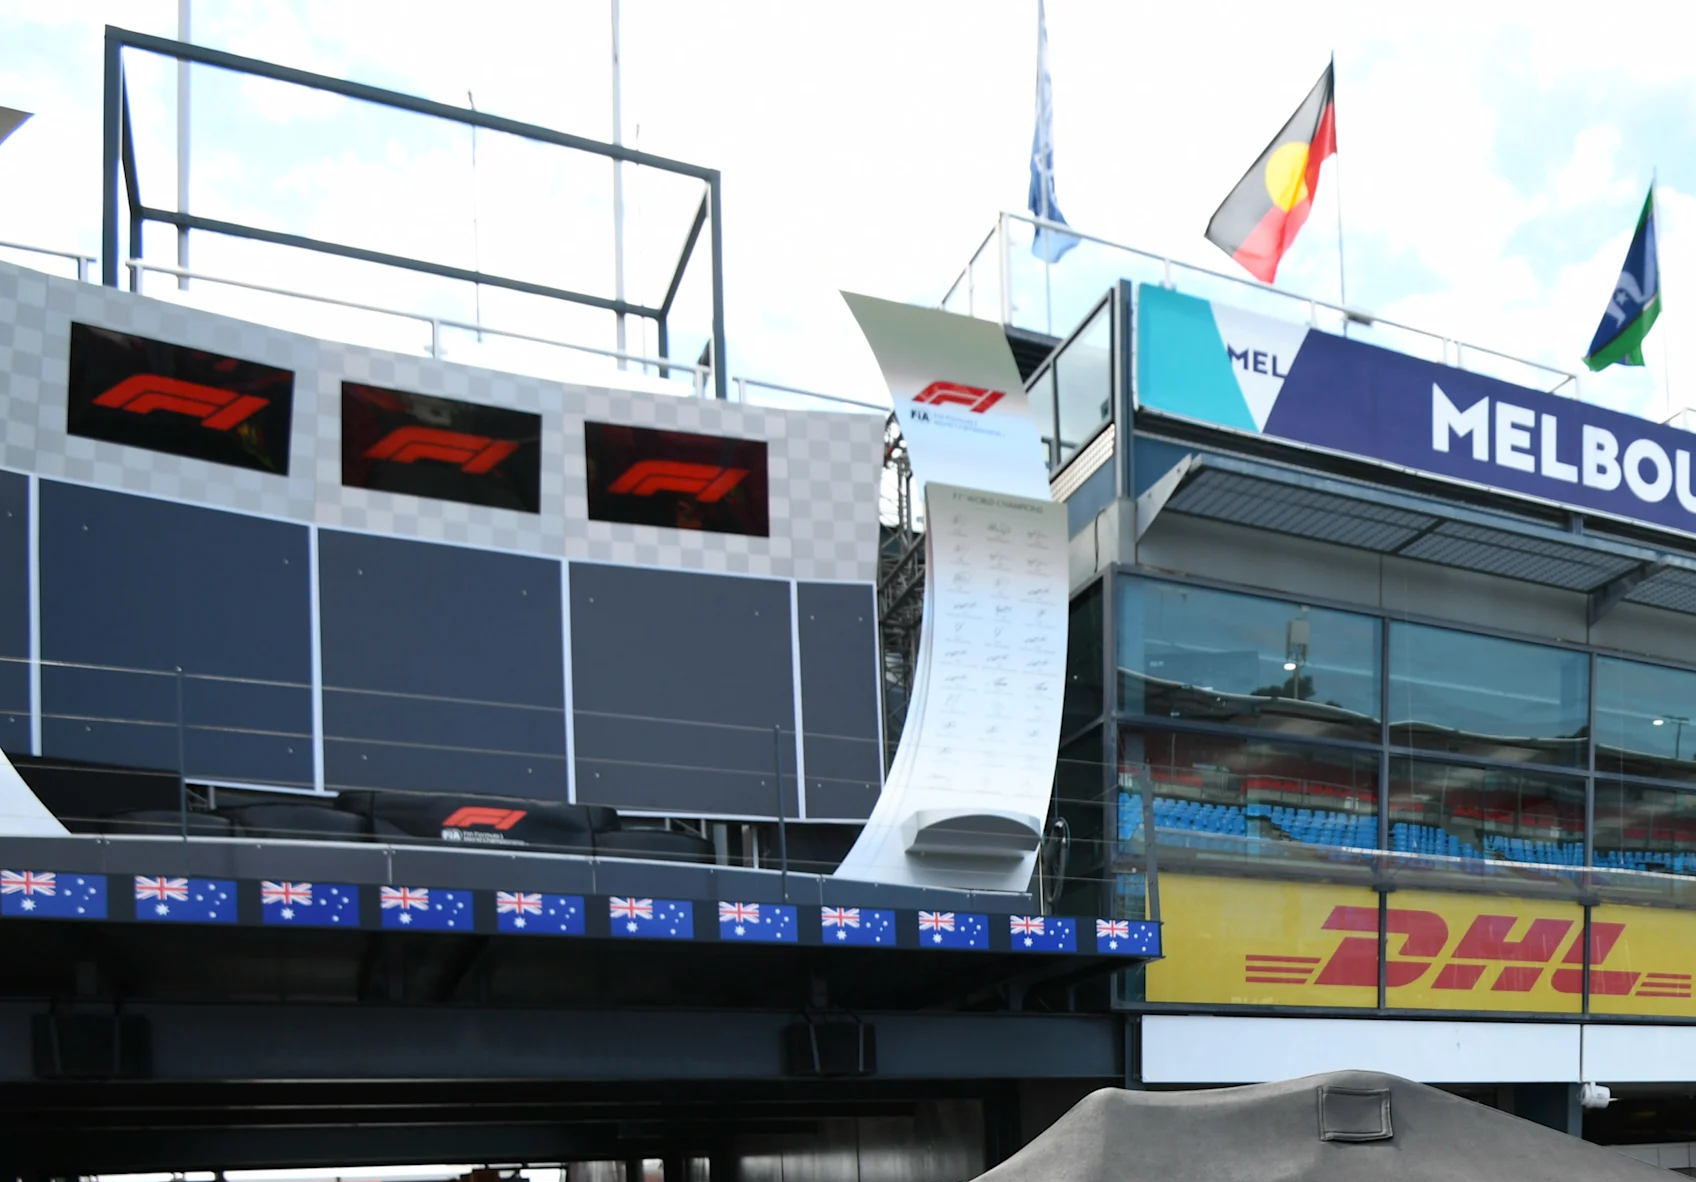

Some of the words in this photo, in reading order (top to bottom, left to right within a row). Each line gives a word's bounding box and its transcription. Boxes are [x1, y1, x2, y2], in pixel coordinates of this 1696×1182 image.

[92, 373, 271, 430] F1
[912, 380, 1007, 414] F1
[364, 426, 520, 474] F1
[608, 459, 749, 502] F1
[442, 806, 527, 830] F1
[1314, 905, 1642, 995] DHL
